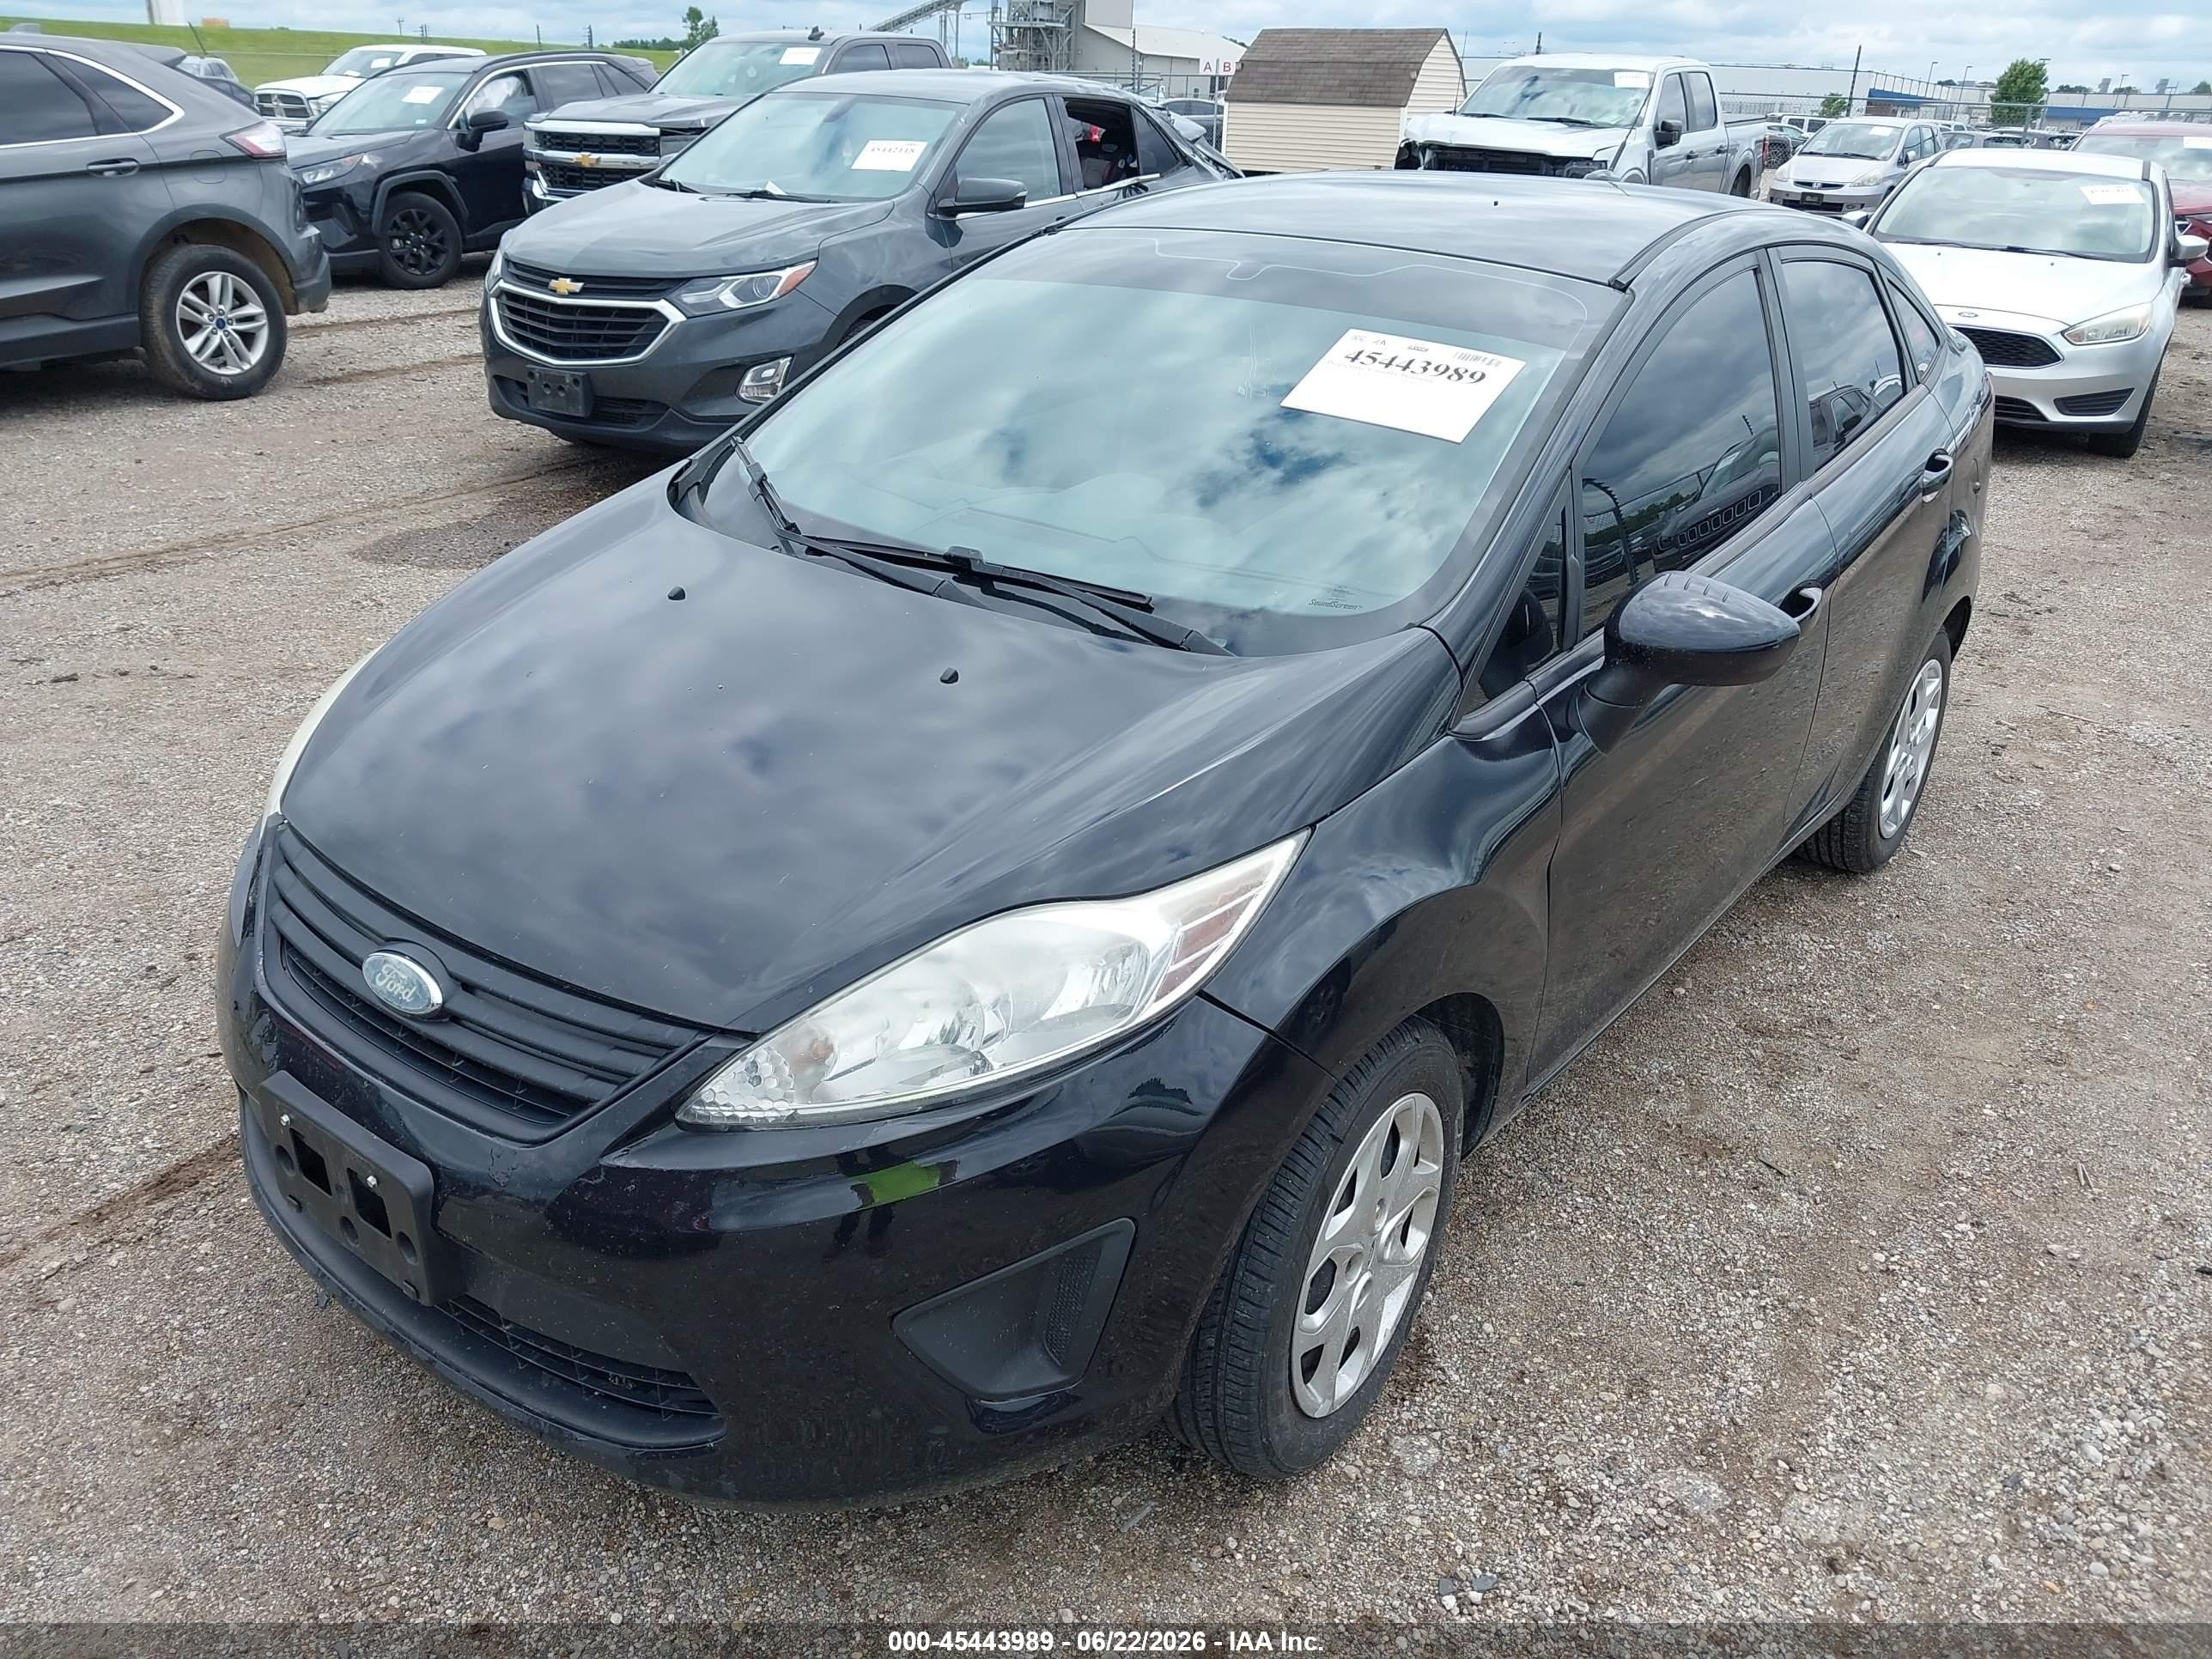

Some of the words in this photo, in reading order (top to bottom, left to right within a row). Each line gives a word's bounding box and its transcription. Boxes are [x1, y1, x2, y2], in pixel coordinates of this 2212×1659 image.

[1203, 61, 1212, 72] A
[1223, 62, 1231, 72] B
[1344, 349, 1486, 385] 45443989
[375, 963, 418, 1003] Ford
